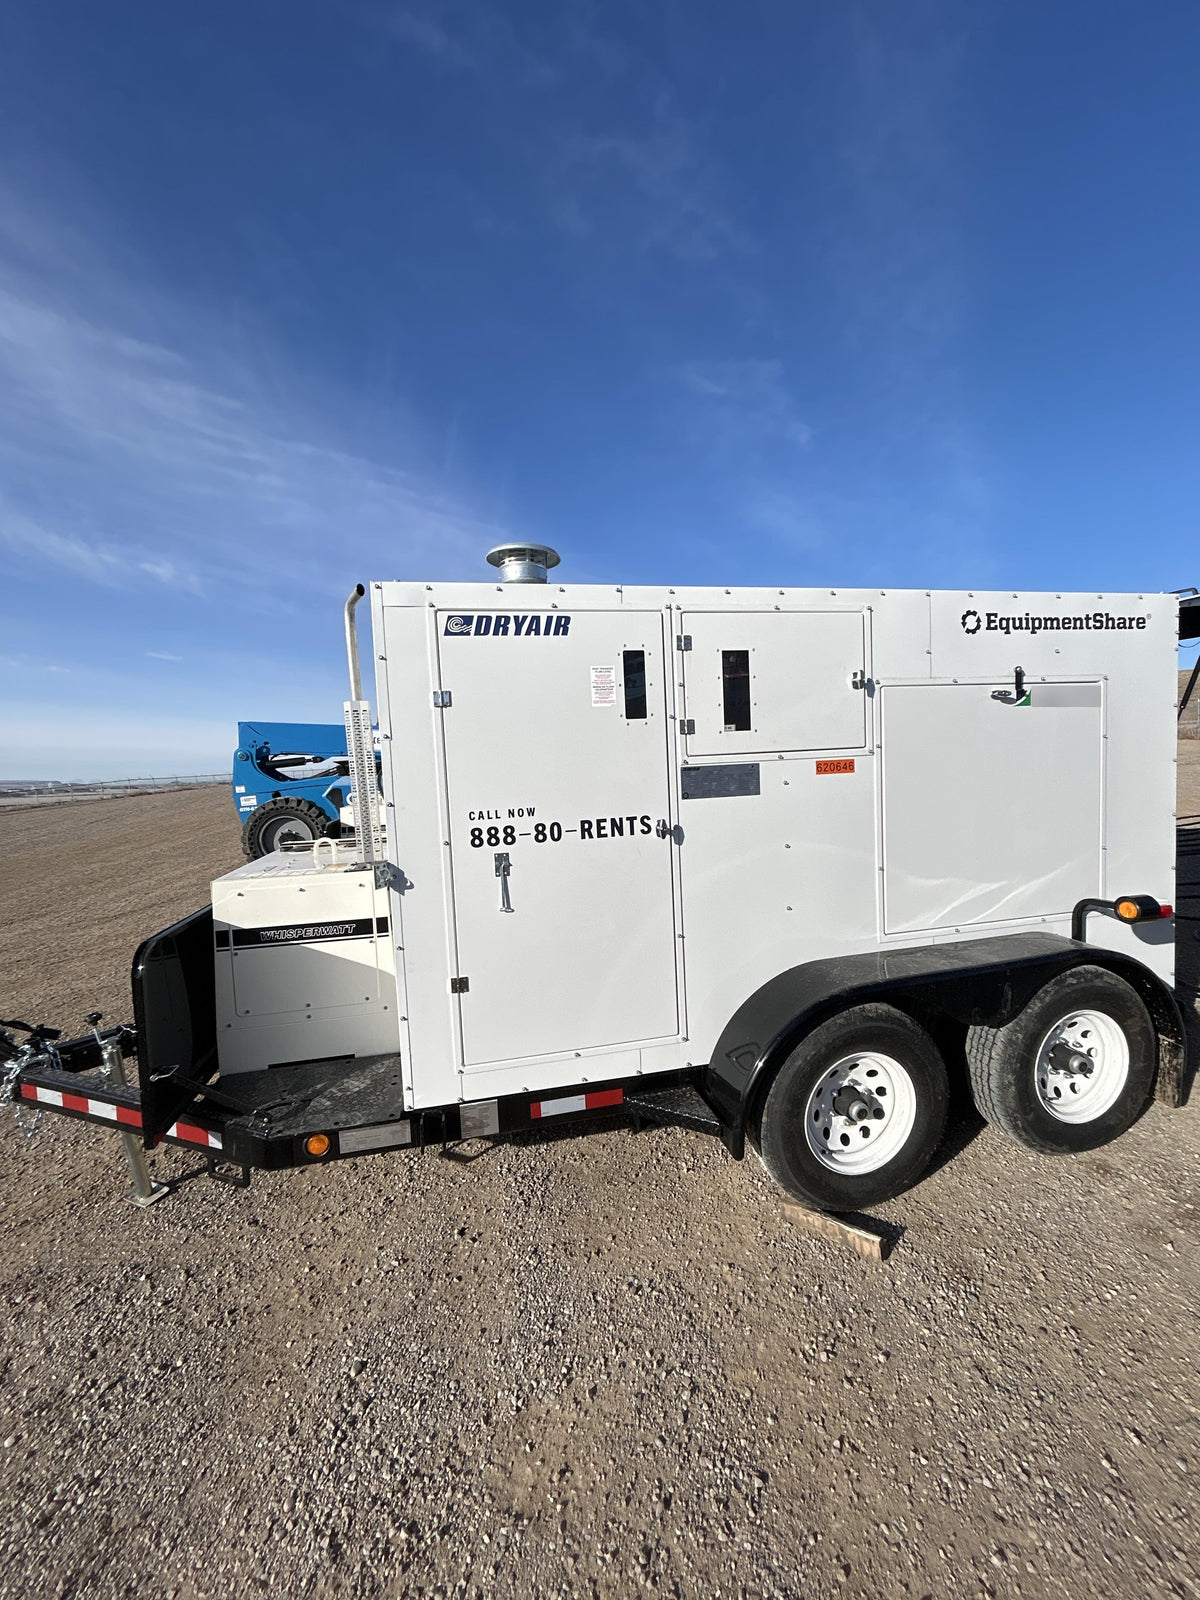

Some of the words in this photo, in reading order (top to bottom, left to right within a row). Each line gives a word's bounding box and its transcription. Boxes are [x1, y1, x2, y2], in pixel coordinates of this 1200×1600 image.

[473, 615, 572, 637] DRYAIR
[816, 761, 854, 773] 620646
[469, 809, 501, 821] CALL
[507, 807, 536, 819] NOW
[259, 923, 356, 942] WHISPERWATT
